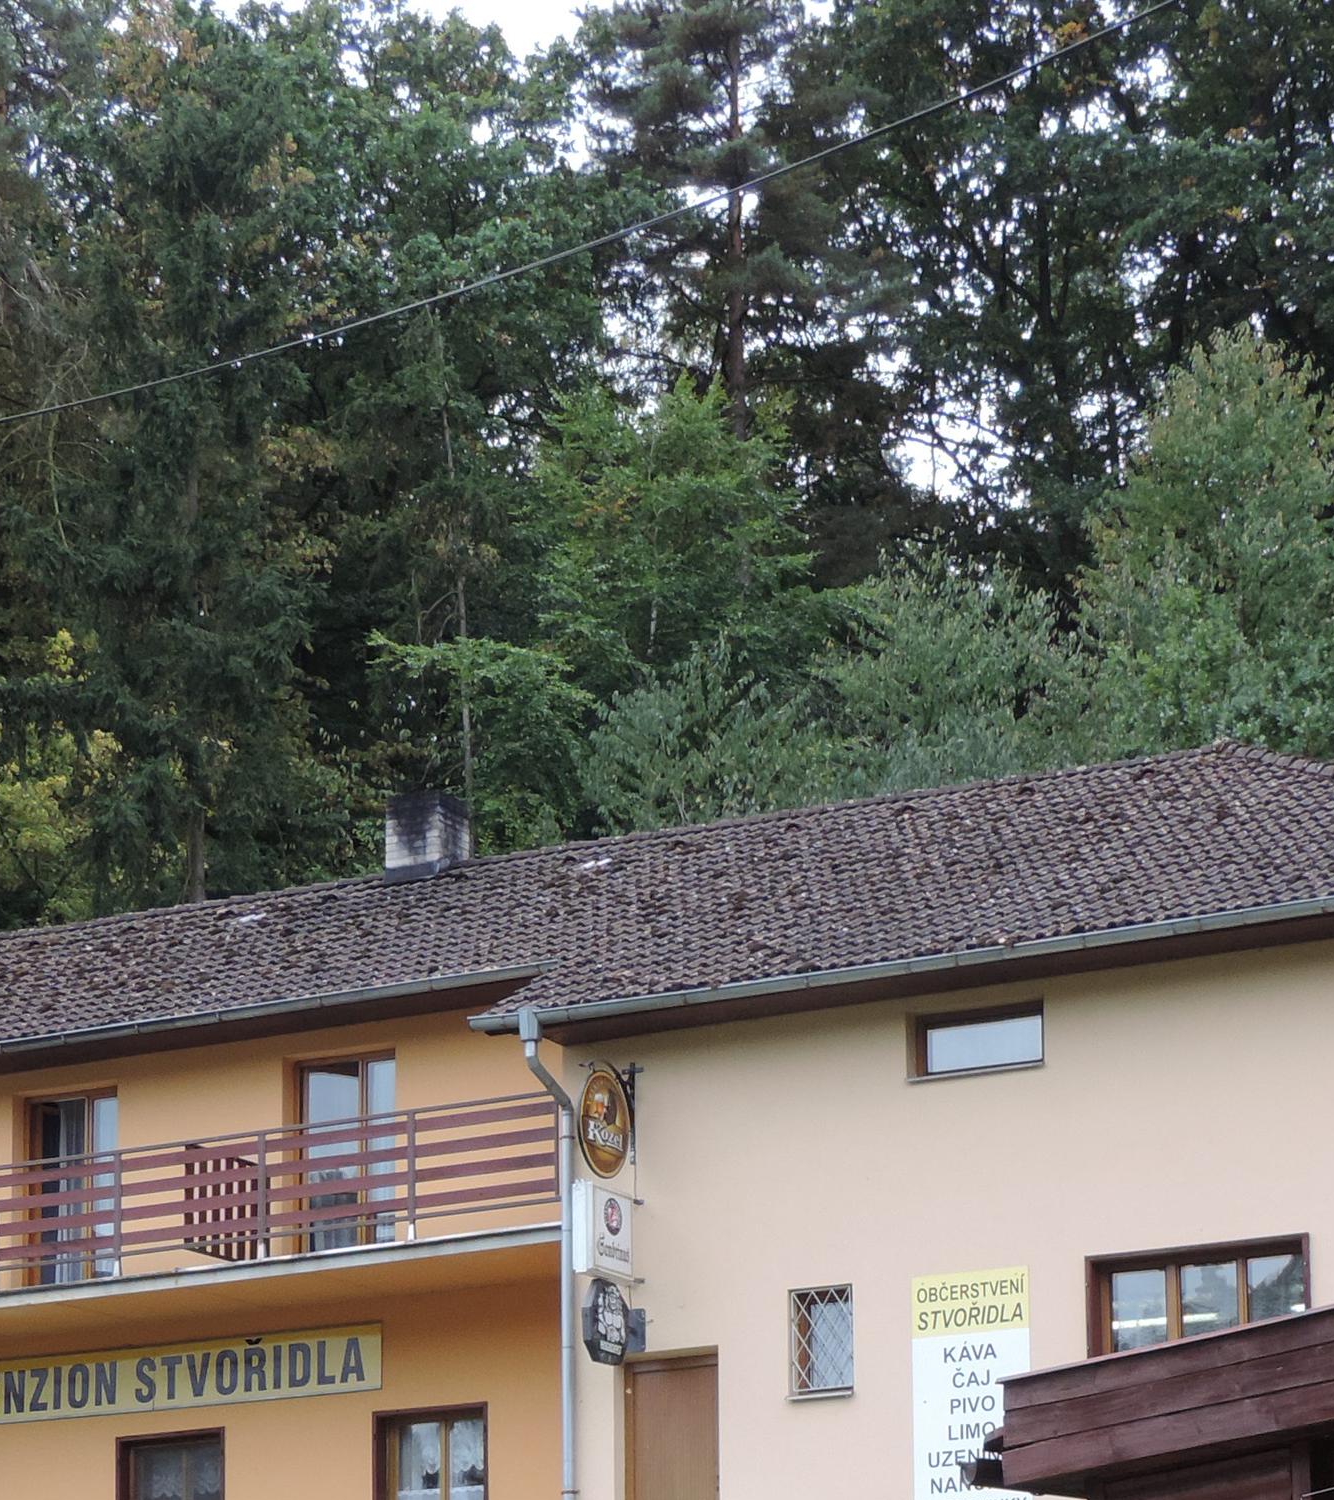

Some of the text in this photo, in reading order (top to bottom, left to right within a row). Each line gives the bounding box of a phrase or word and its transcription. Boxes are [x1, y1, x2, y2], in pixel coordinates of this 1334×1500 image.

[587, 1120, 624, 1152] Kozel
[917, 1273, 1025, 1304] OBČERSTVENÍ
[917, 1301, 1024, 1331] STVOŘIDLA
[943, 1341, 997, 1363] KÁVA
[135, 1337, 366, 1403] STVOŘIDLA
[952, 1367, 990, 1388] ČAJ
[950, 1395, 995, 1415] PIVO
[948, 1421, 996, 1441] LIMO
